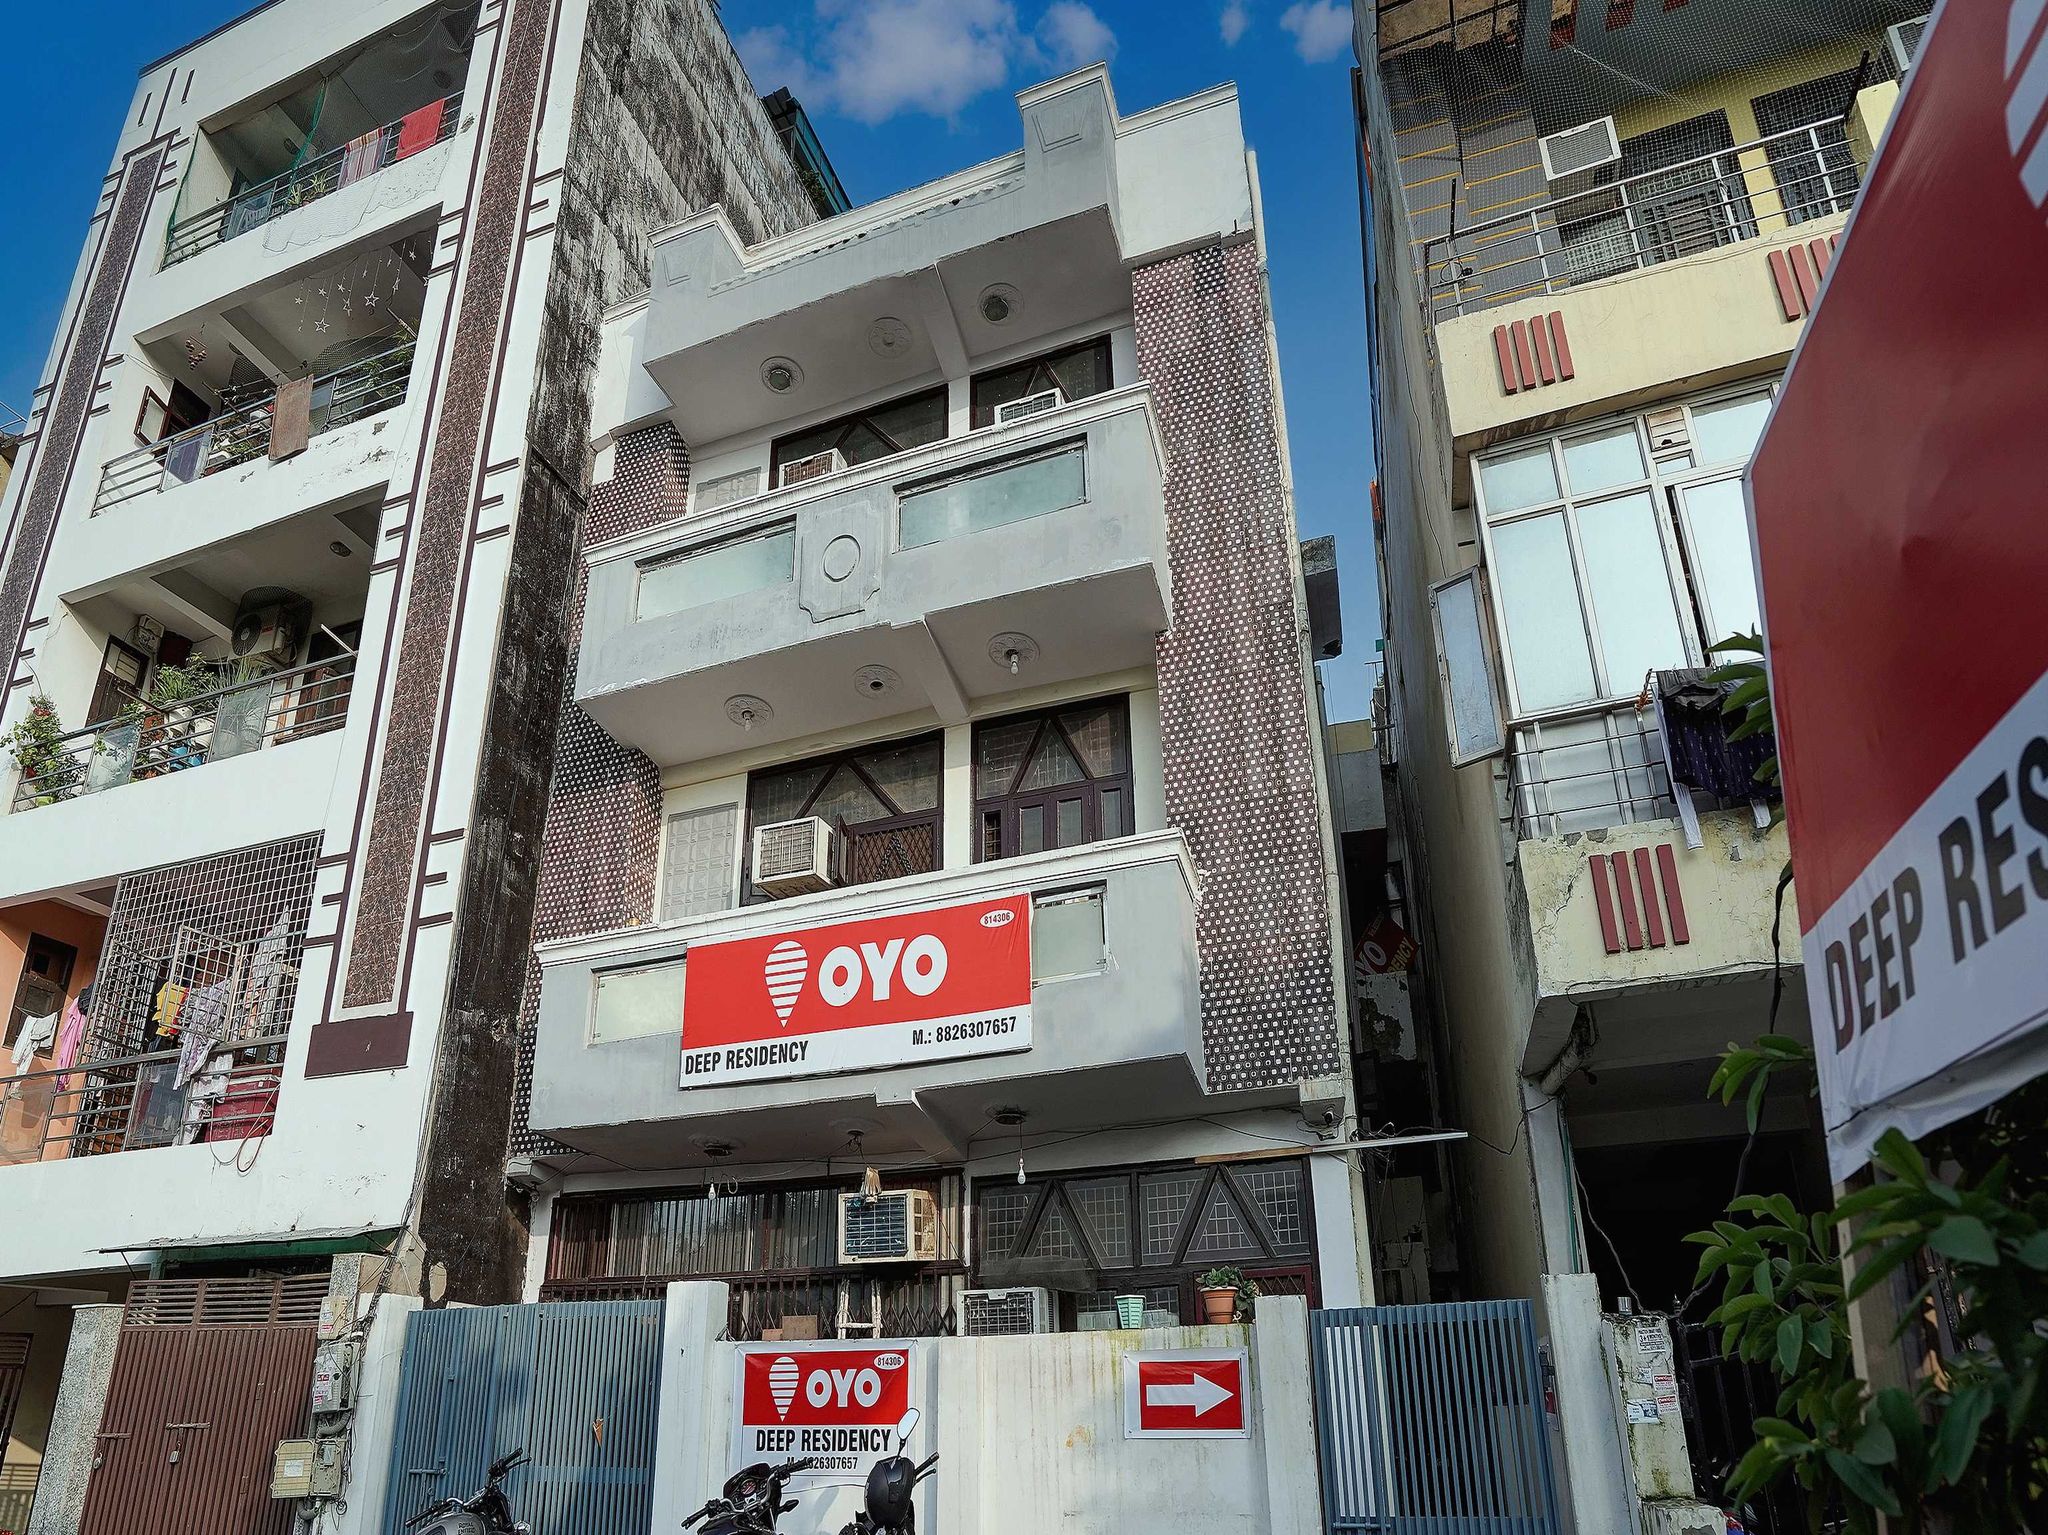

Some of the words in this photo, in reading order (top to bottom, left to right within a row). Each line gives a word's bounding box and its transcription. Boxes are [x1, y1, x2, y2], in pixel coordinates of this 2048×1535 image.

[983, 911, 1012, 926] 814306
[818, 934, 948, 1007] OYO
[1355, 941, 1387, 976] YO
[1825, 866, 1923, 1055] DEEP
[912, 1028, 932, 1046] M.:
[936, 1016, 1017, 1044] 8826307657
[685, 1050, 721, 1076] DEEP
[725, 1040, 809, 1071] RESIDENCY
[877, 1356, 902, 1366] 814306
[805, 1368, 882, 1408] OYO
[756, 1429, 795, 1452] DEEP
[801, 1428, 891, 1452] RESIDENCY
